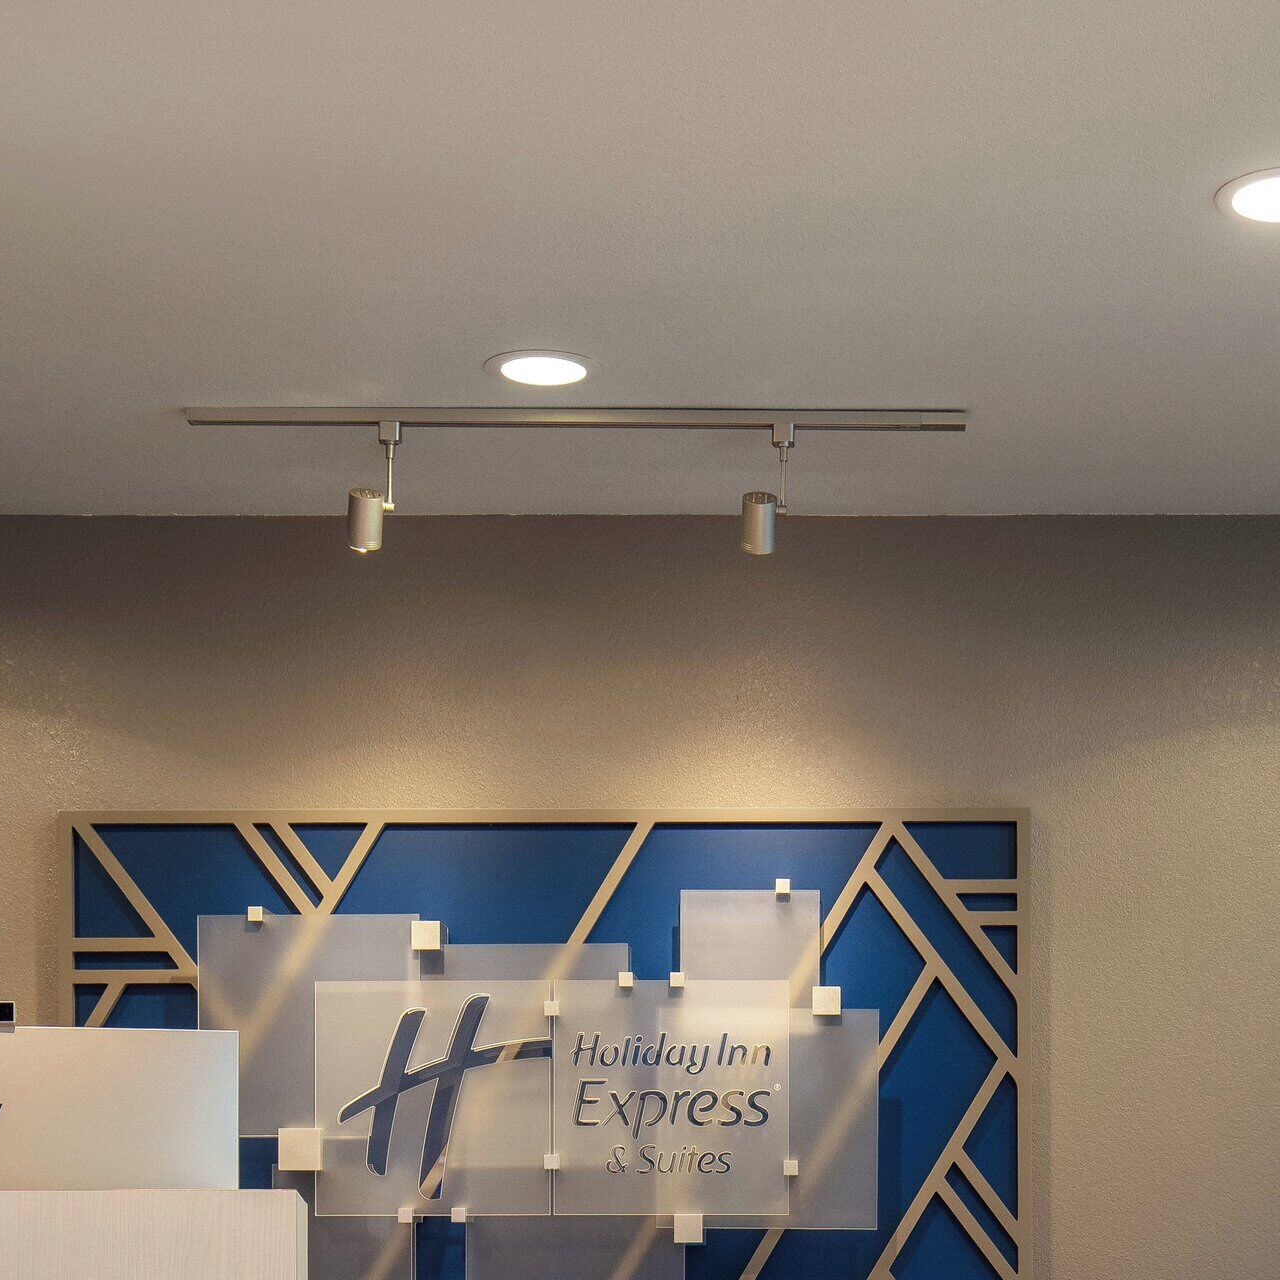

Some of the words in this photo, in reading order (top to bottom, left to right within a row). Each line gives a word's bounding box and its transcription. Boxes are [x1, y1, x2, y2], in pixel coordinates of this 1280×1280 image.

[570, 1031, 710, 1075] Holiday
[716, 1031, 772, 1067] Inn
[605, 1144, 628, 1175] &
[635, 1143, 733, 1175] Suites
